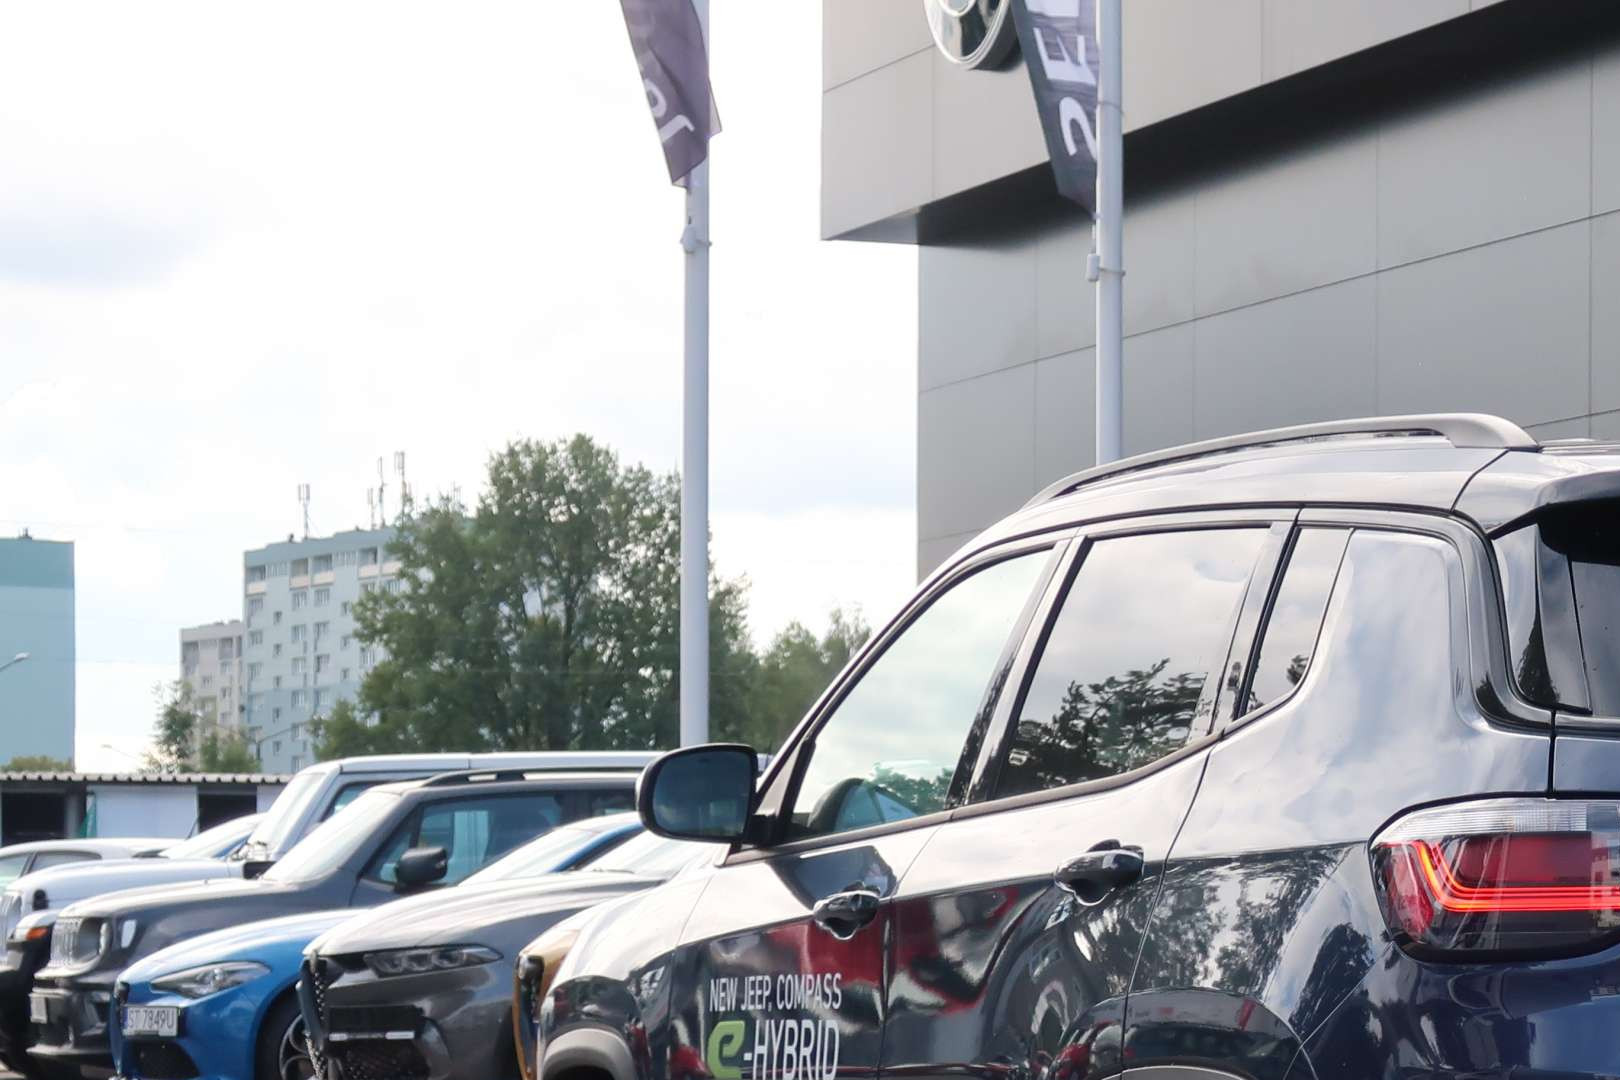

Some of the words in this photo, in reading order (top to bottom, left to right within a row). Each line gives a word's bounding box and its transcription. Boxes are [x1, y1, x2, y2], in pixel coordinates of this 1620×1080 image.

[709, 977, 739, 1013] NEW
[776, 972, 843, 1011] COMPASS
[128, 1009, 141, 1028] ST
